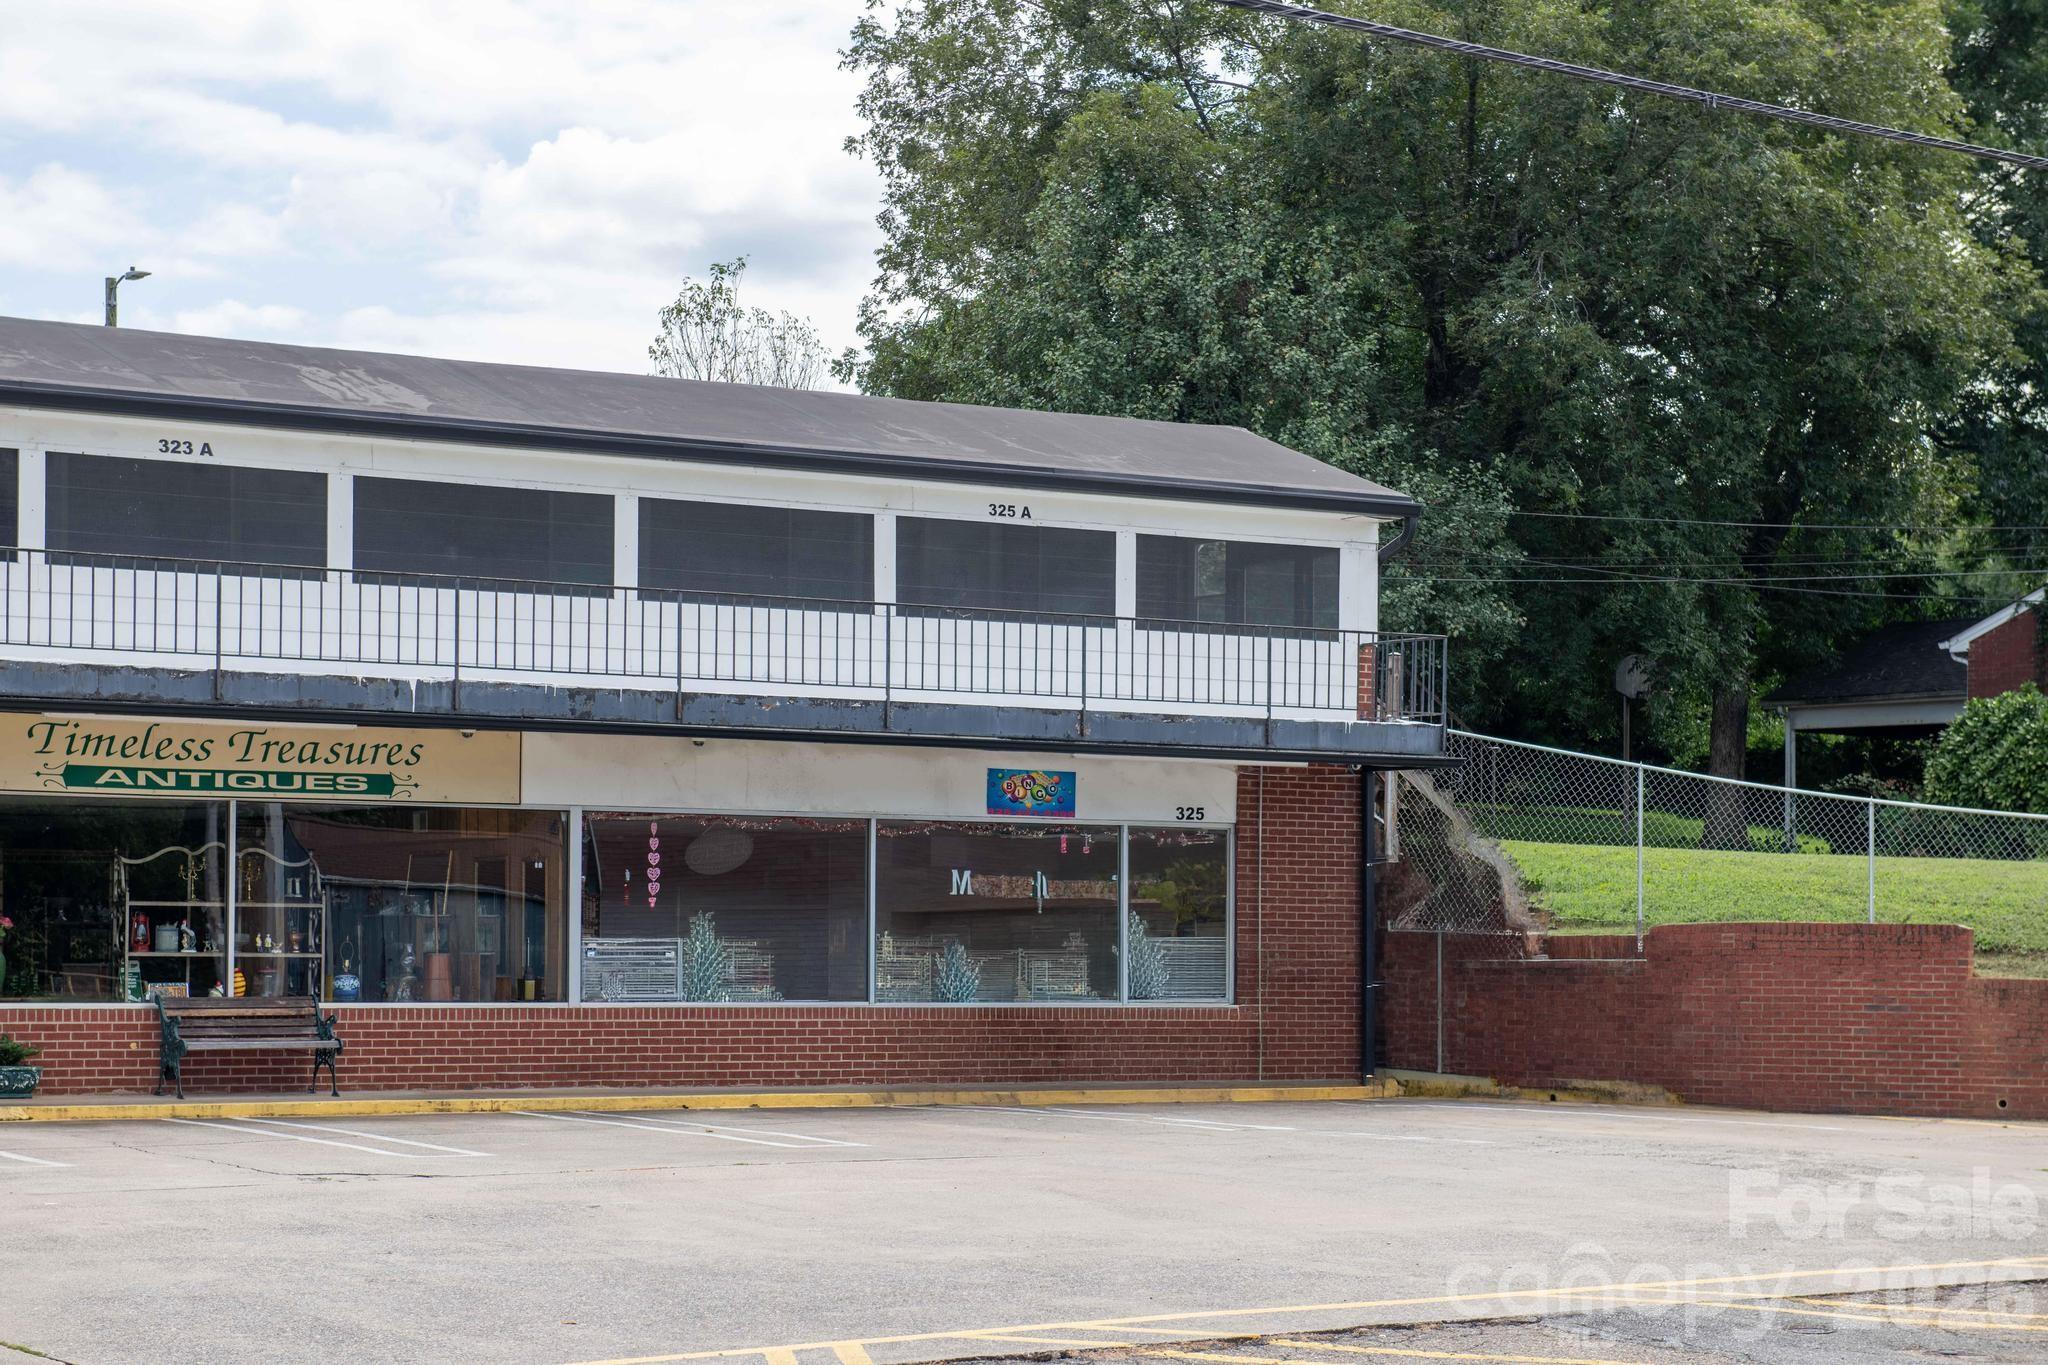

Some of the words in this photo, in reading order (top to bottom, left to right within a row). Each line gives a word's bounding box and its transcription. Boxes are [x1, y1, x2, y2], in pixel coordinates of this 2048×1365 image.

[159, 439, 193, 455] 323
[200, 443, 214, 456] A
[989, 503, 1016, 518] 325
[1021, 506, 1031, 519] A
[27, 720, 215, 763] Timeless
[228, 728, 424, 767] Treasures
[95, 768, 369, 792] ANTIQUES
[1004, 779, 1057, 799] BINGO
[1176, 806, 1204, 821] 325
